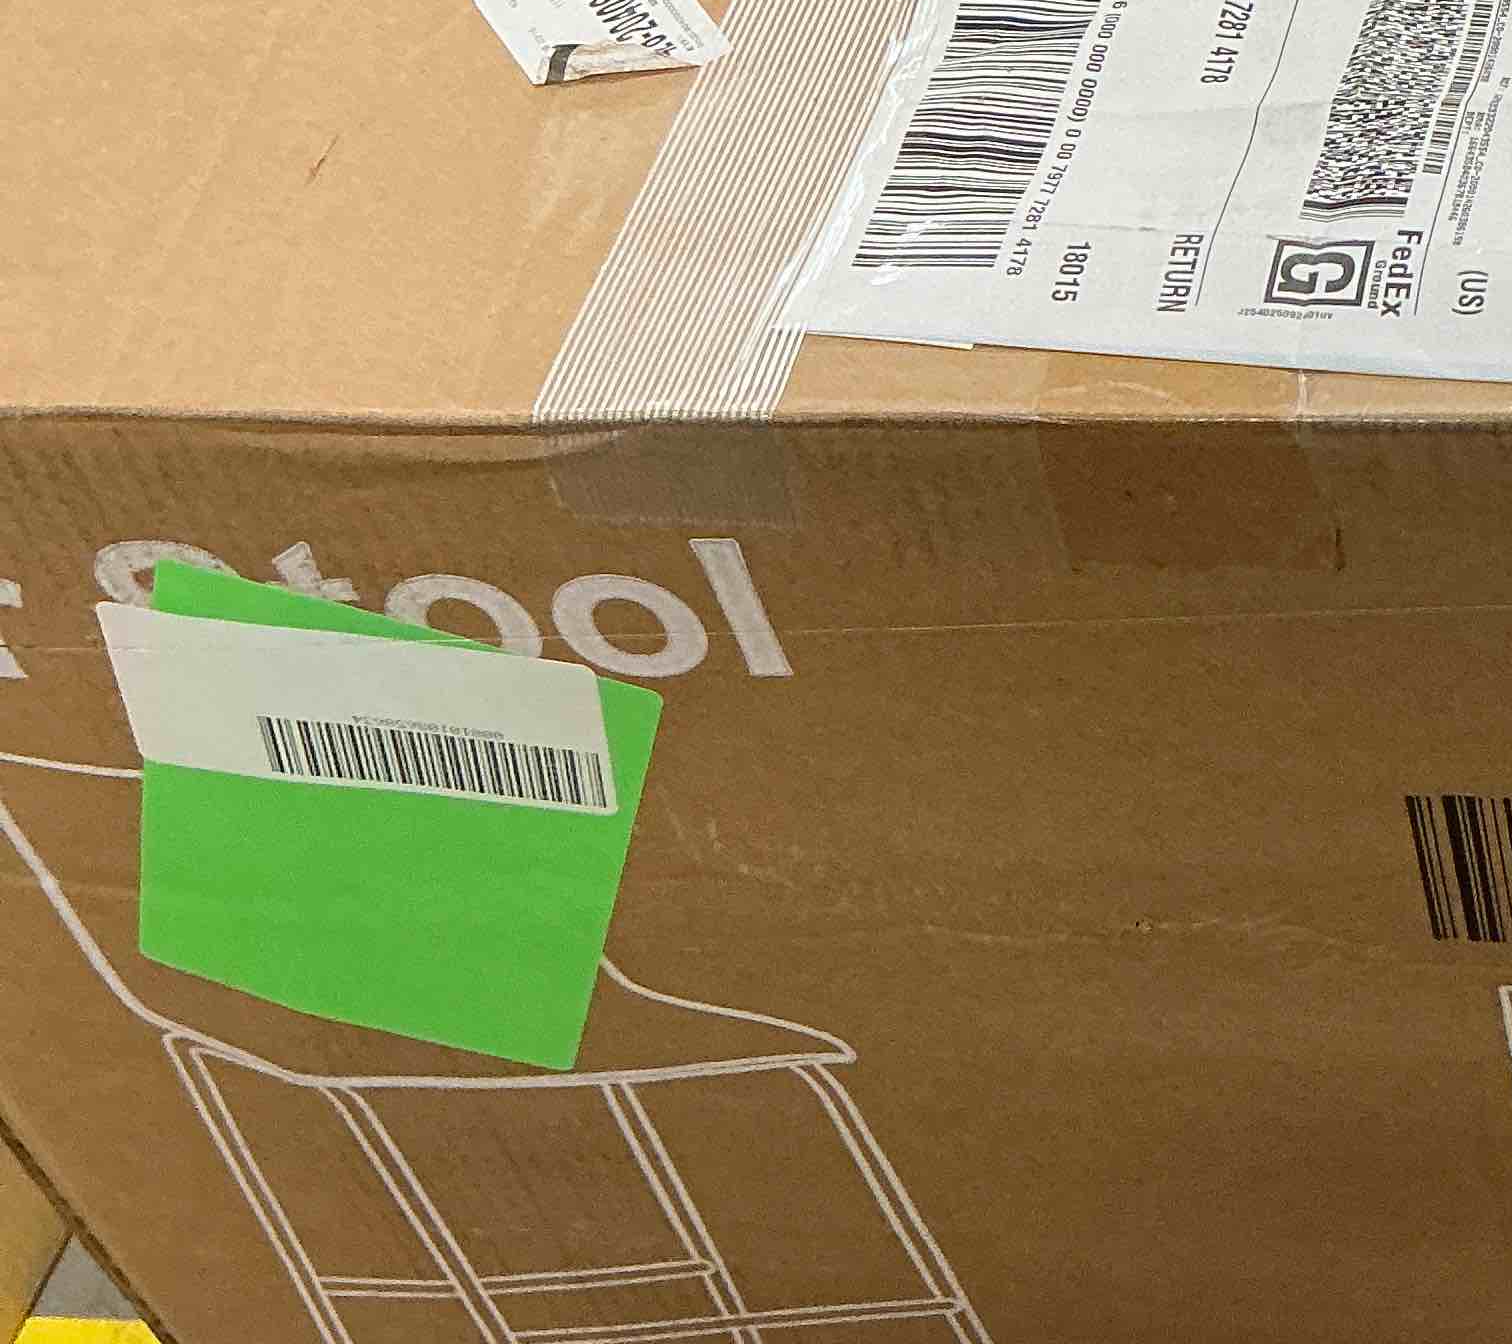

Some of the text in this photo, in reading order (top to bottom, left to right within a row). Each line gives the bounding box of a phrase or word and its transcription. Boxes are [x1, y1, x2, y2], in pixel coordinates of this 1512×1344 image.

[1112, 0, 1128, 9] 6
[1215, 0, 1254, 41] 7281
[1097, 12, 1121, 40] (000
[1085, 43, 1109, 73] 000
[1200, 47, 1239, 85] 4178
[1067, 78, 1098, 123] 0000)
[1056, 142, 1077, 161] 00
[1064, 128, 1083, 138] 0
[1040, 164, 1069, 196] 7977
[1021, 197, 1051, 231] 7281
[1006, 237, 1034, 277] 4178
[1050, 241, 1092, 302] 18015
[1156, 233, 1205, 314] RETURN
[1277, 251, 1356, 295] G
[1380, 229, 1424, 318] FedEx
[1367, 259, 1388, 310] Ground
[1451, 270, 1489, 316] (US)
